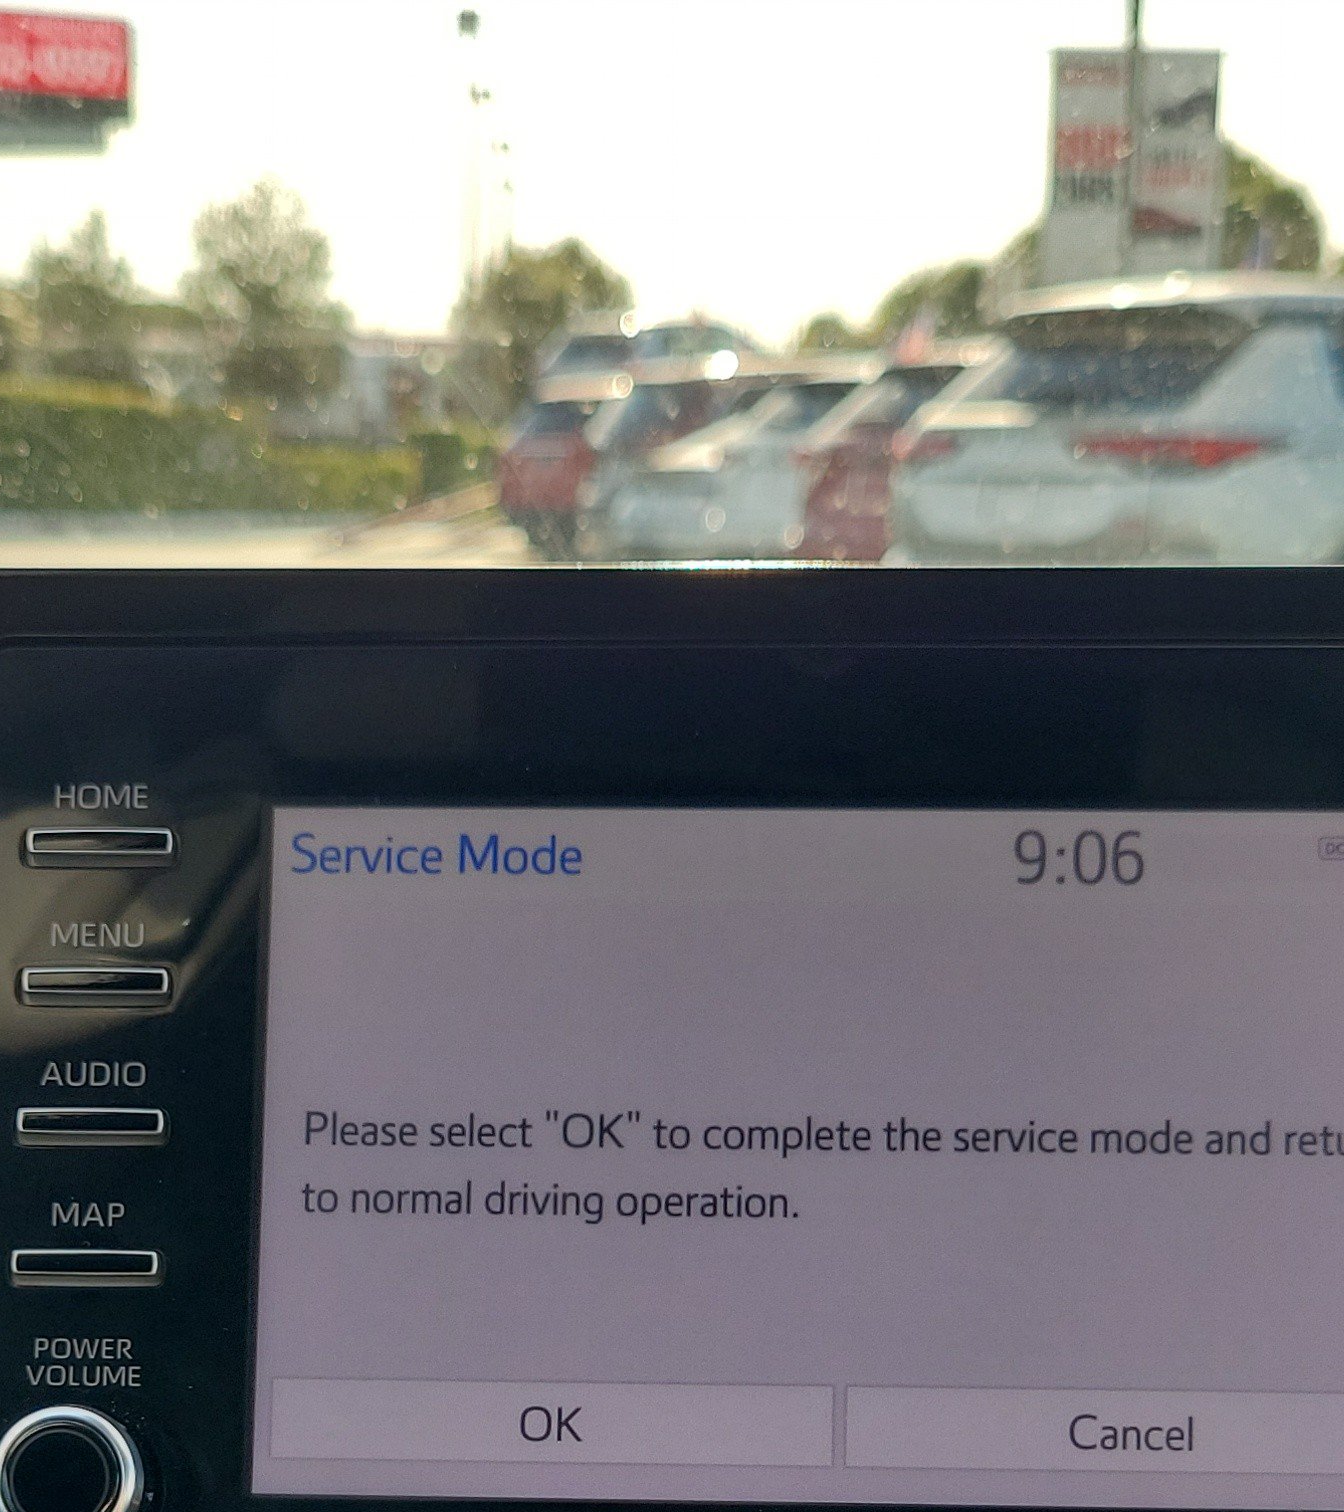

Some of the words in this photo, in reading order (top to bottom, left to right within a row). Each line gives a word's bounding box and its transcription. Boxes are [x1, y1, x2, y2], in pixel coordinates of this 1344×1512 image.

[55, 784, 149, 809] HOME
[290, 831, 444, 876] Service
[459, 833, 583, 876] Mode
[1013, 829, 1146, 886] 9:06
[50, 923, 145, 948] MENU
[40, 1061, 147, 1088] AUDIO
[304, 1110, 419, 1149] Please
[429, 1113, 533, 1149] select
[545, 1110, 642, 1150] "OK"
[653, 1117, 692, 1151] to
[702, 1114, 871, 1158] complete
[883, 1117, 942, 1153] the
[953, 1119, 1079, 1154] service
[1090, 1120, 1194, 1156] mode
[1204, 1121, 1272, 1156] and
[51, 1202, 125, 1227] MAP
[302, 1183, 340, 1216] to
[351, 1180, 472, 1217] normal
[484, 1181, 604, 1226] driving
[616, 1185, 800, 1226] operation.
[33, 1338, 133, 1360] POWER
[26, 1365, 142, 1387] VOLUME
[519, 1406, 583, 1444] OK
[1068, 1414, 1195, 1453] Cancel
